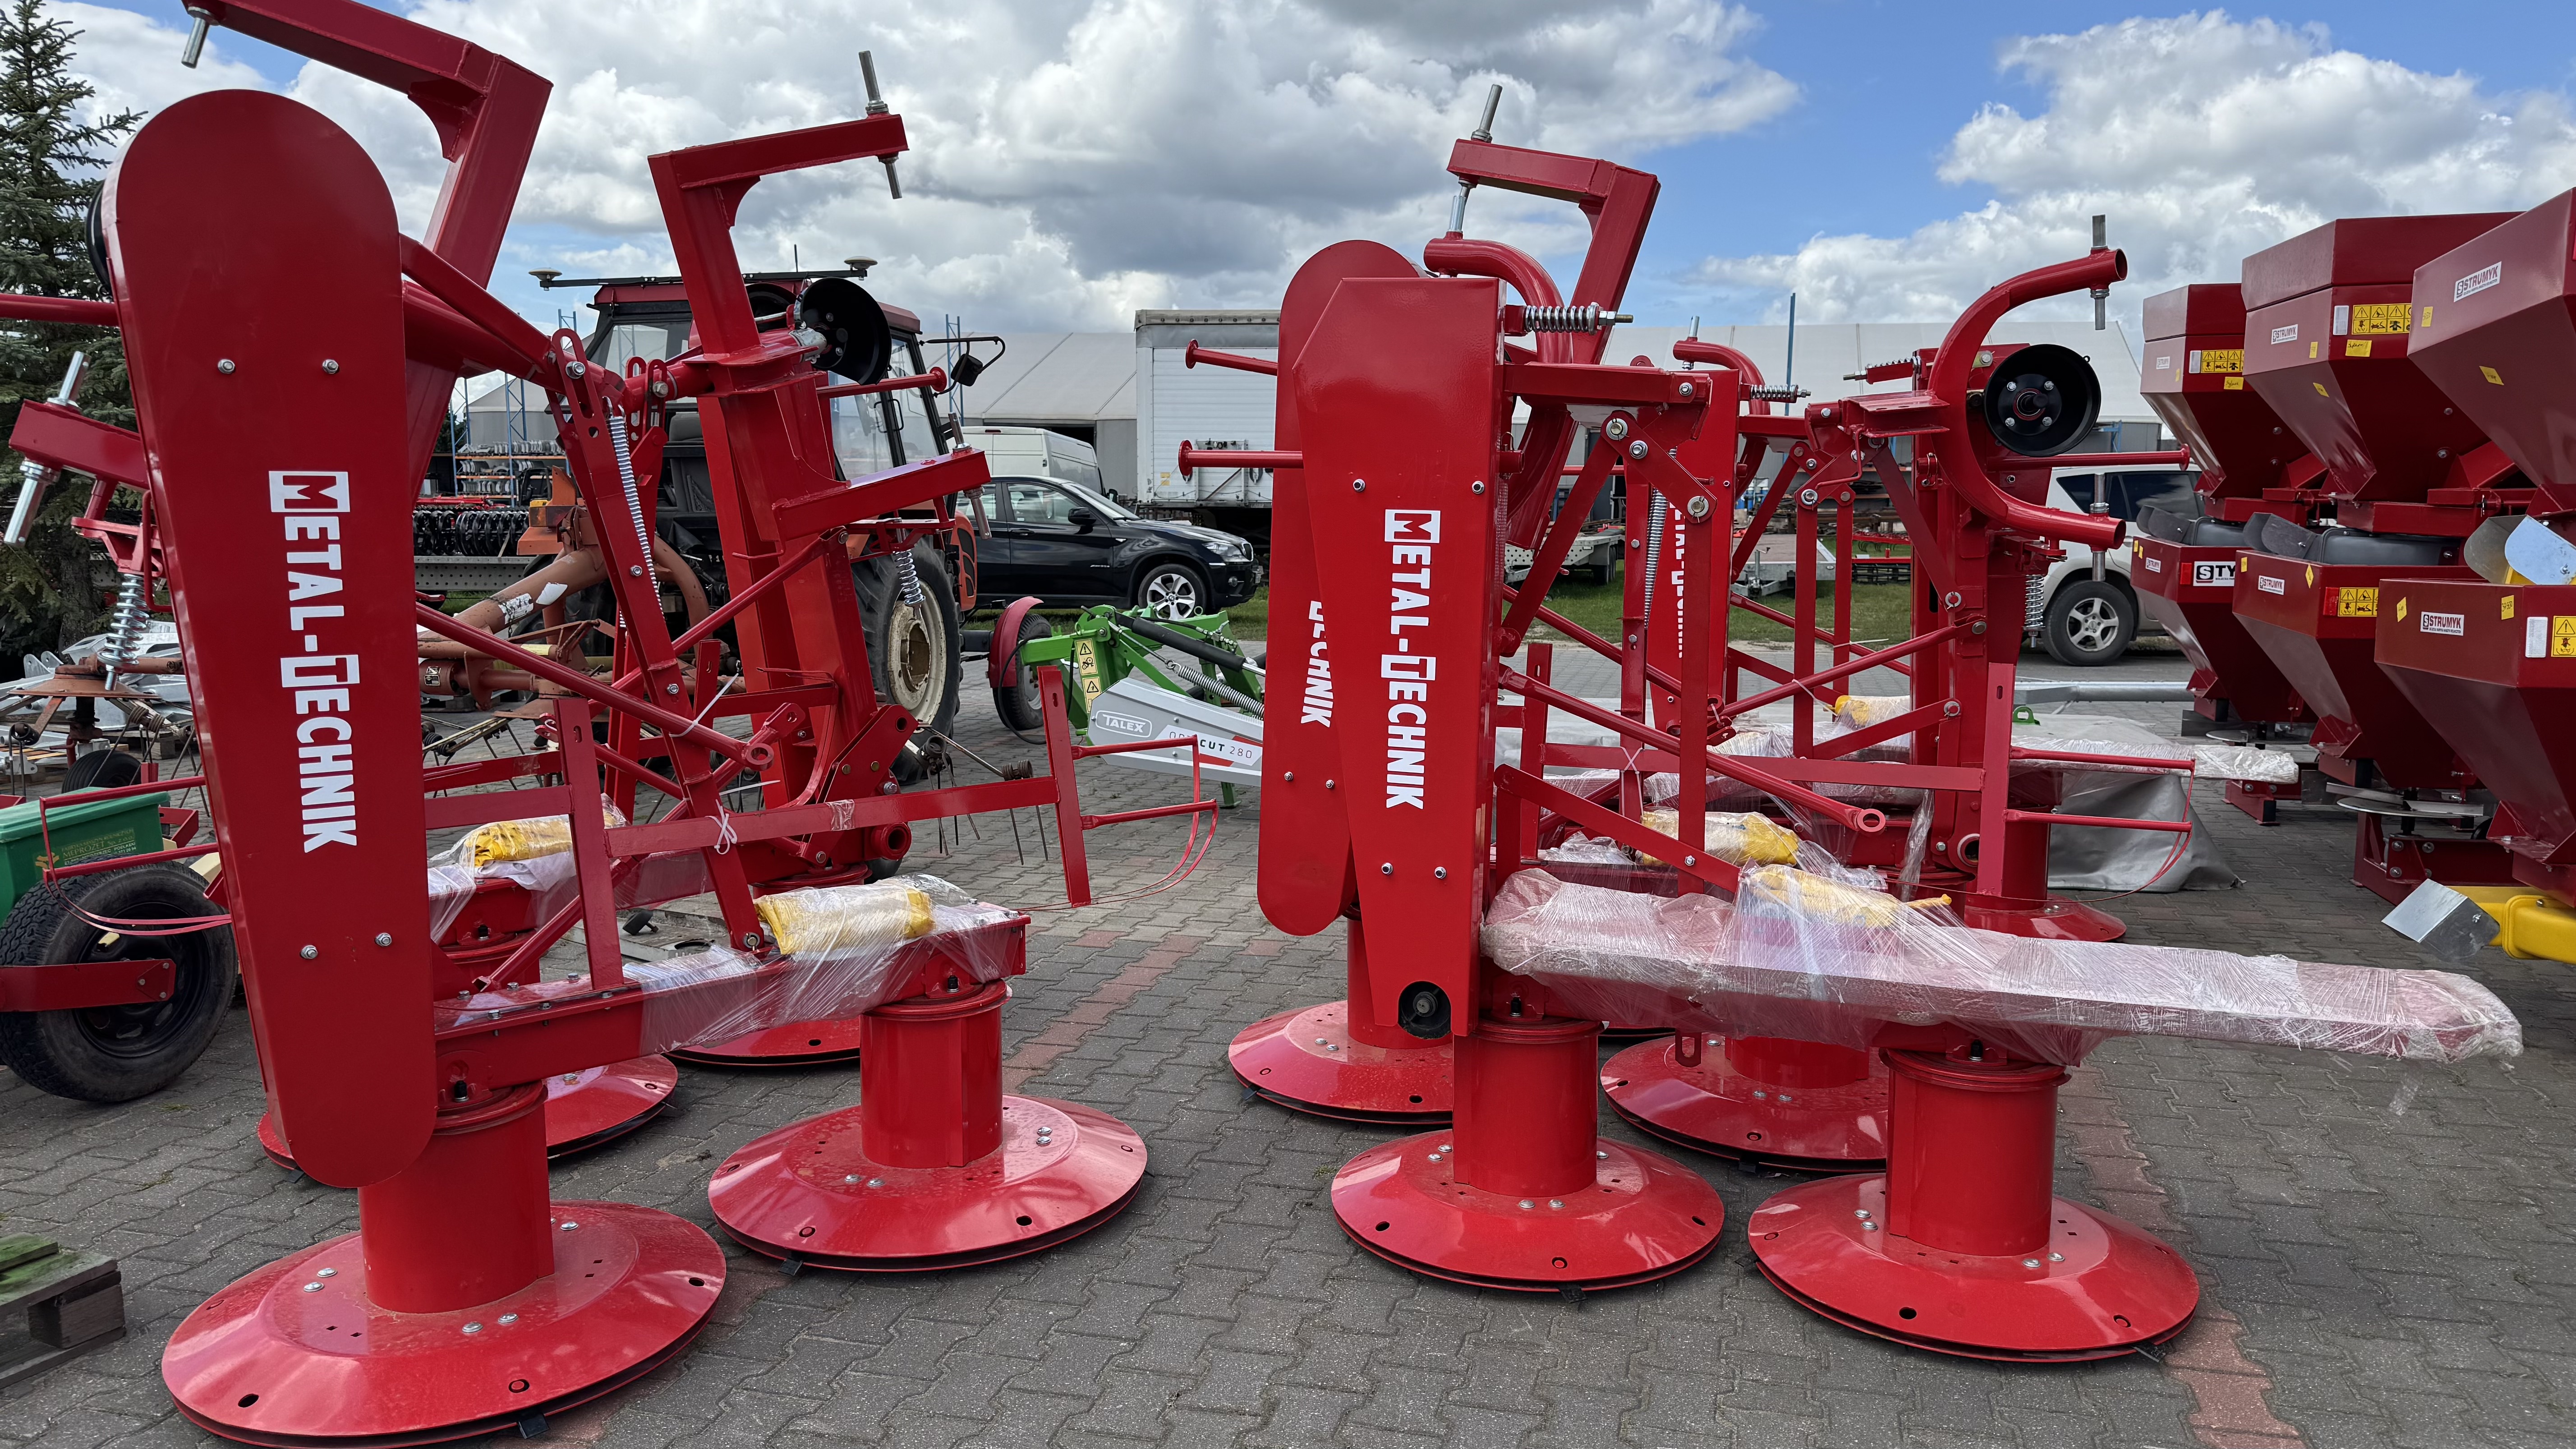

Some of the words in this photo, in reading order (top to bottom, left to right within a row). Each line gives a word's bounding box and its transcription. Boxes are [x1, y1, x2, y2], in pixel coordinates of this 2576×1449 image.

[2464, 265, 2498, 291] STRUMYK
[2429, 616, 2461, 629] STRUMYK
[269, 471, 360, 853] METAL-TECHNIK
[1381, 510, 1441, 810] METAL-TECHNIK
[1102, 714, 1146, 733] TALEX
[1229, 746, 1252, 759] 280
[63, 841, 104, 857] MEPROZET
